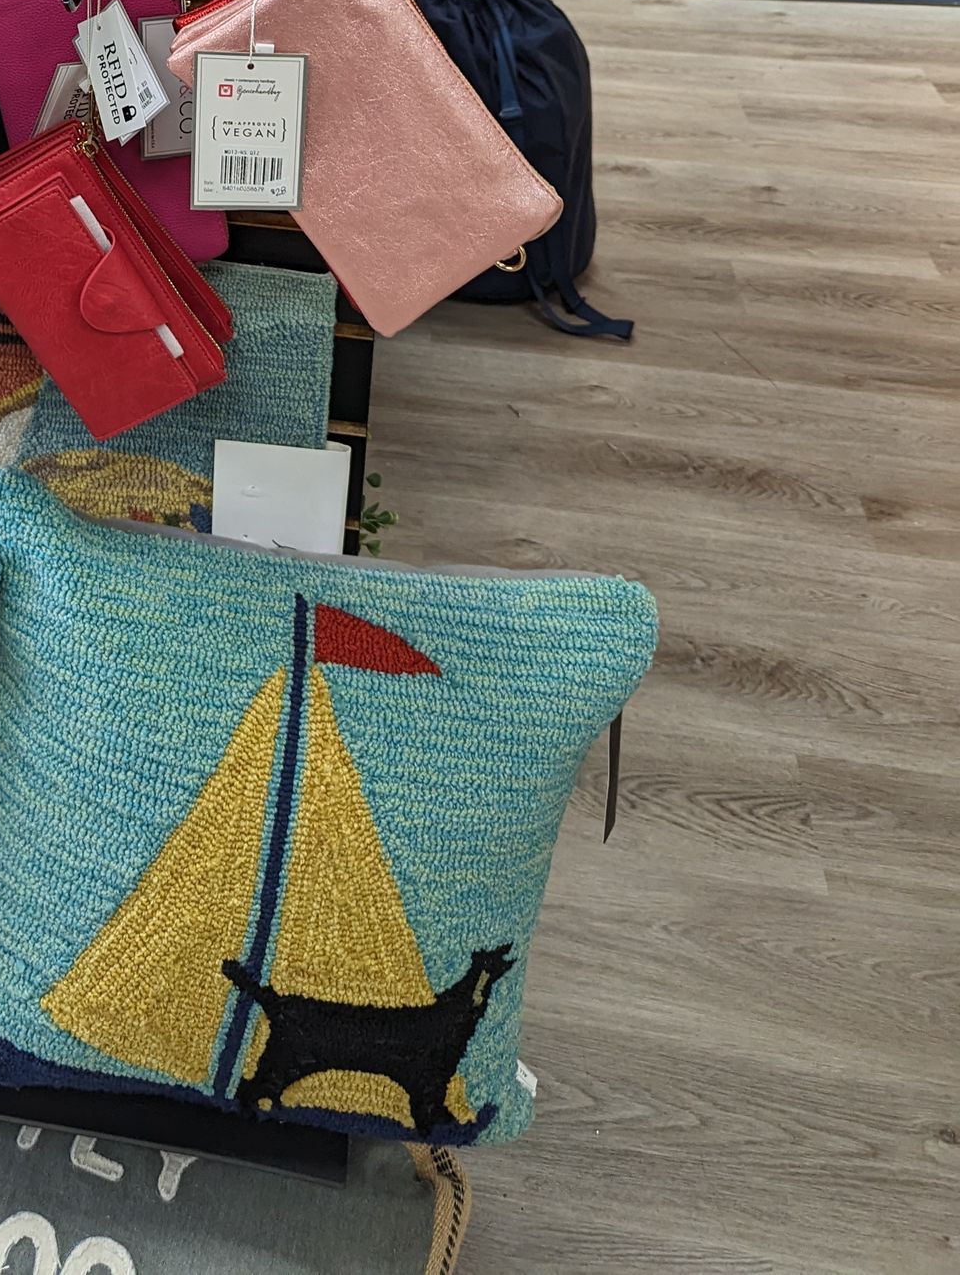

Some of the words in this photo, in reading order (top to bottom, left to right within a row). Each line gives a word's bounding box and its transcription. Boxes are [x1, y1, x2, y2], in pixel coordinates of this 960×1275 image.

[97, 53, 121, 125] PROTECTED
[104, 40, 128, 100] RFID
[63, 88, 81, 120] PROTEC
[222, 127, 276, 138] VEGAN
